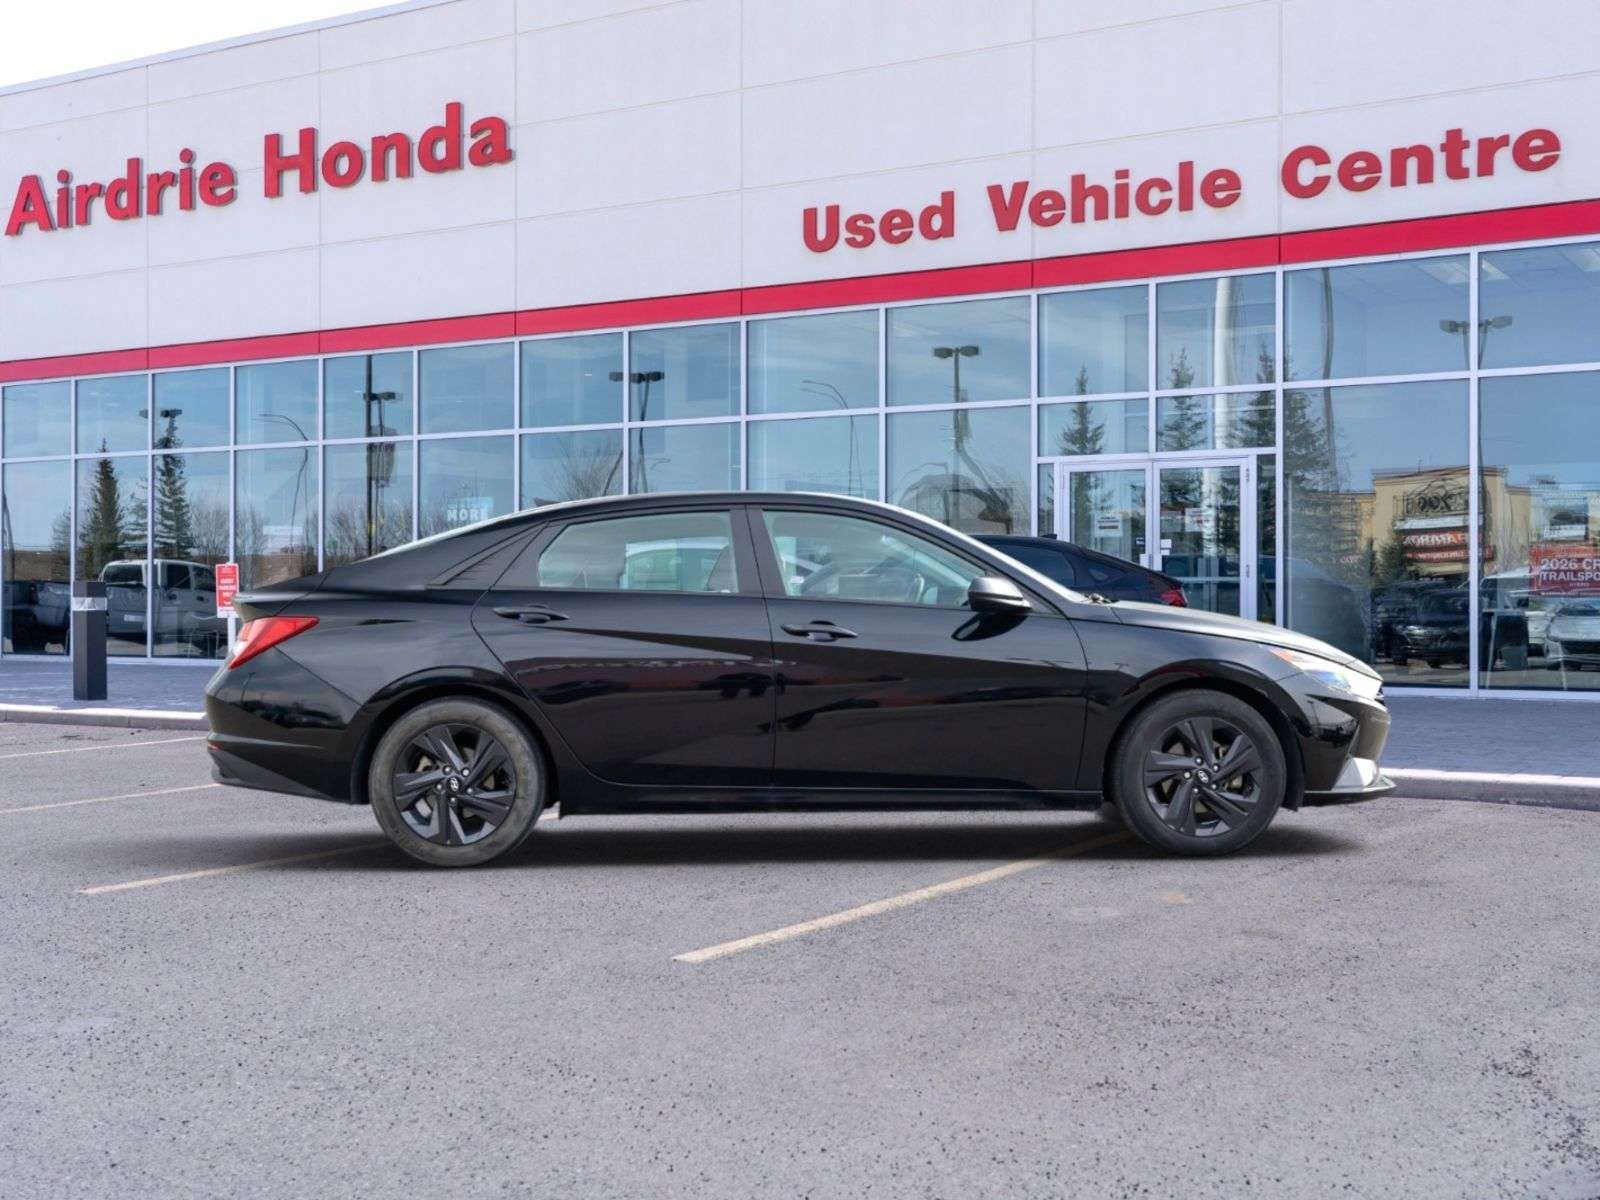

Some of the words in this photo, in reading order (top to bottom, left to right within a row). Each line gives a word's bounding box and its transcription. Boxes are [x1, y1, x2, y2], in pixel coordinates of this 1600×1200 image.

[5, 149, 237, 235] Airdrie
[265, 102, 513, 198] Honda
[803, 192, 955, 253] Used
[987, 161, 1241, 232] Vehicle
[1281, 128, 1560, 199] Centre
[1540, 558, 1578, 570] 2026
